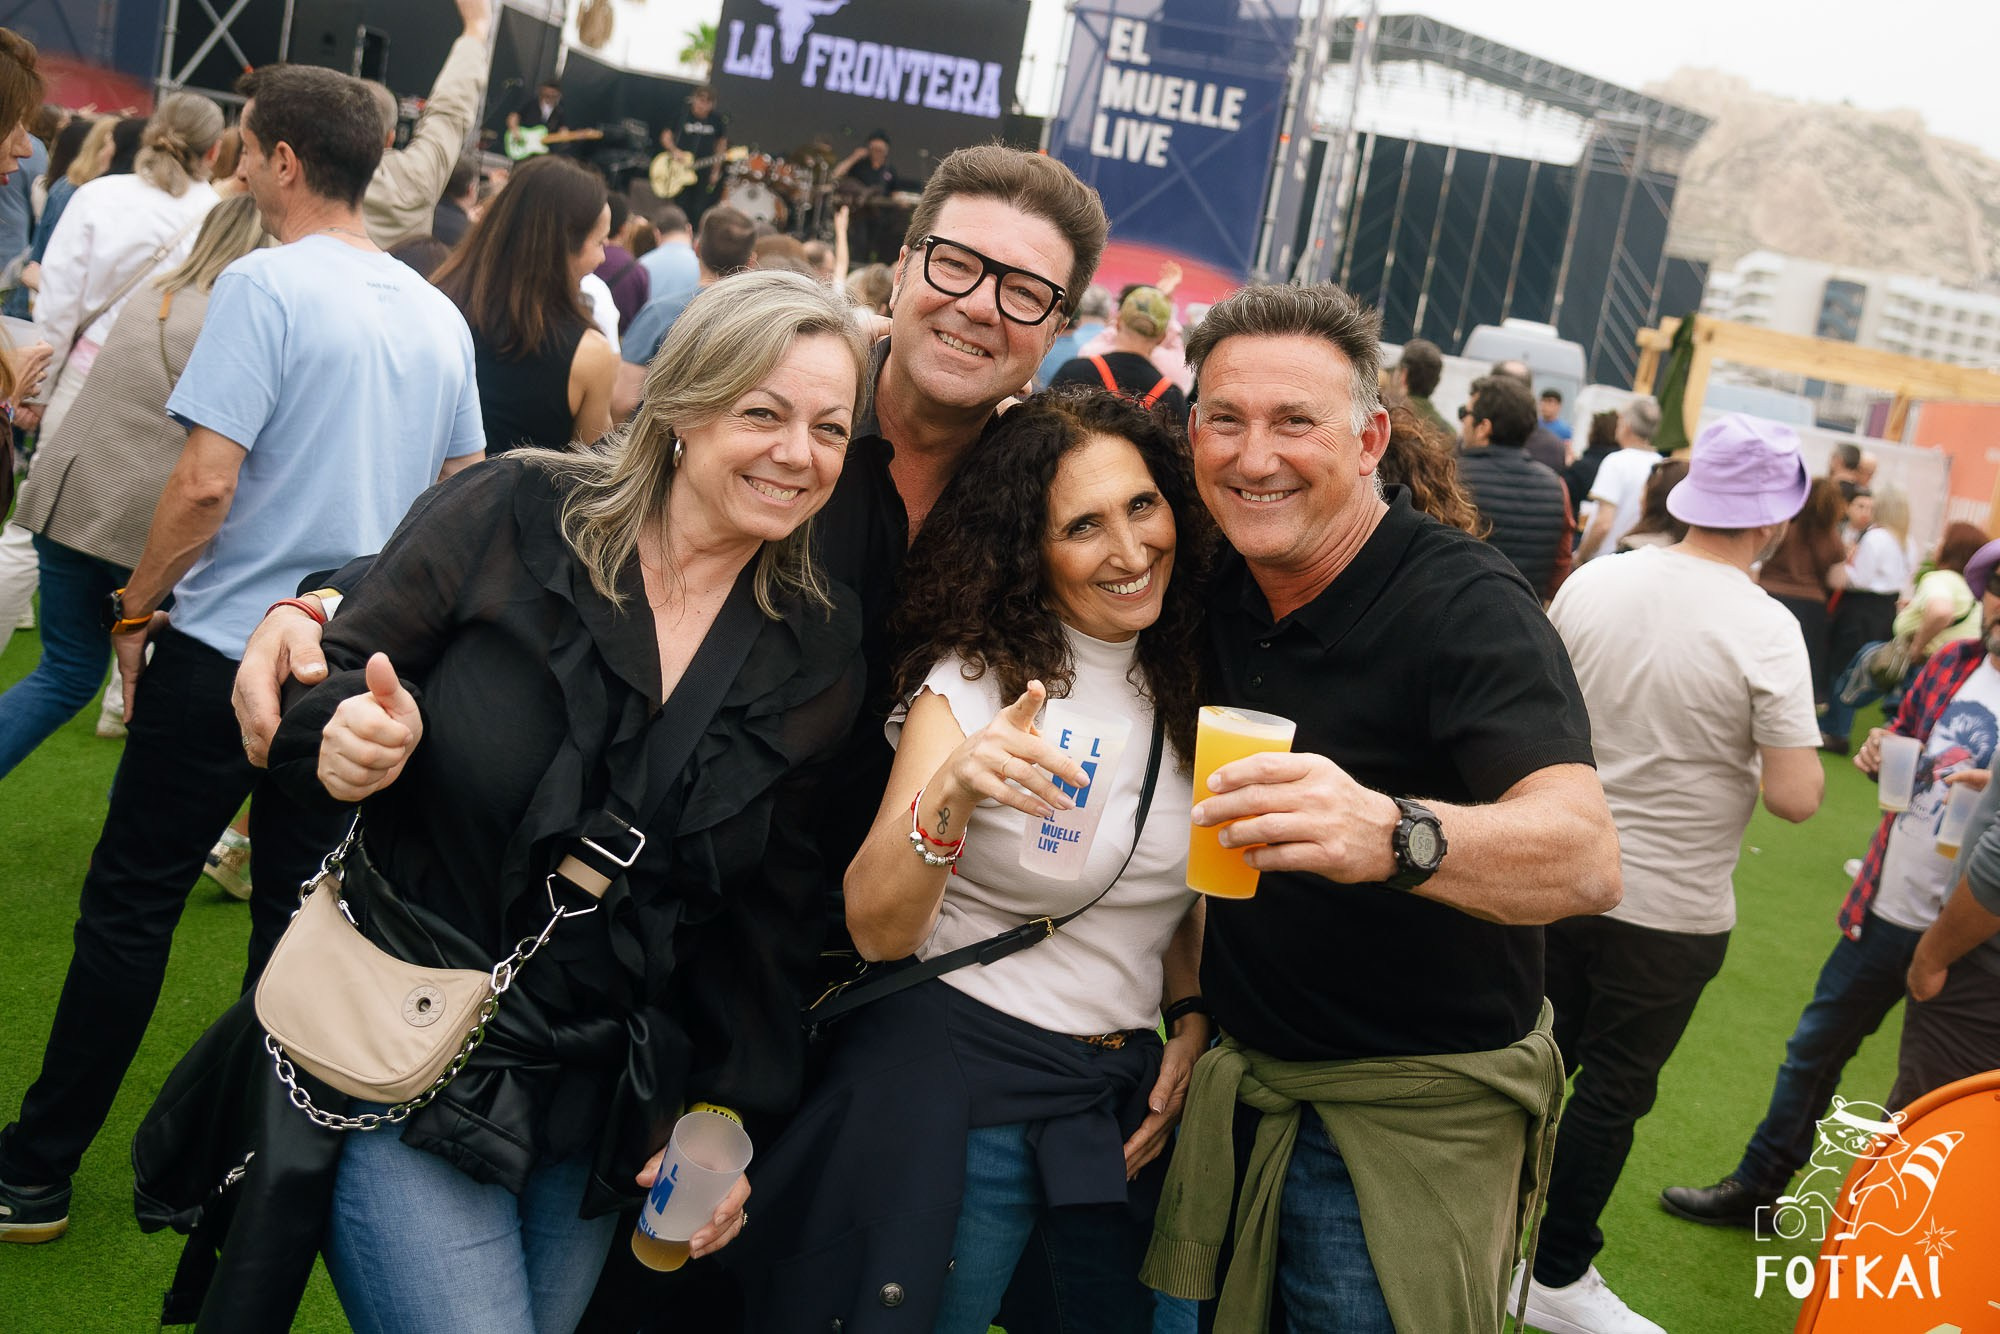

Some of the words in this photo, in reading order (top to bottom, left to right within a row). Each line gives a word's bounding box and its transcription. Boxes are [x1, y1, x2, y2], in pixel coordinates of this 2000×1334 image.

[1107, 16, 1150, 65] EL
[723, 19, 775, 80] LA
[802, 33, 1002, 118] FRONTERA
[1100, 65, 1247, 131] MUELLE
[1090, 112, 1173, 168] LIVE
[1038, 837, 1059, 853] LIVE
[1041, 823, 1081, 842] MUELLE
